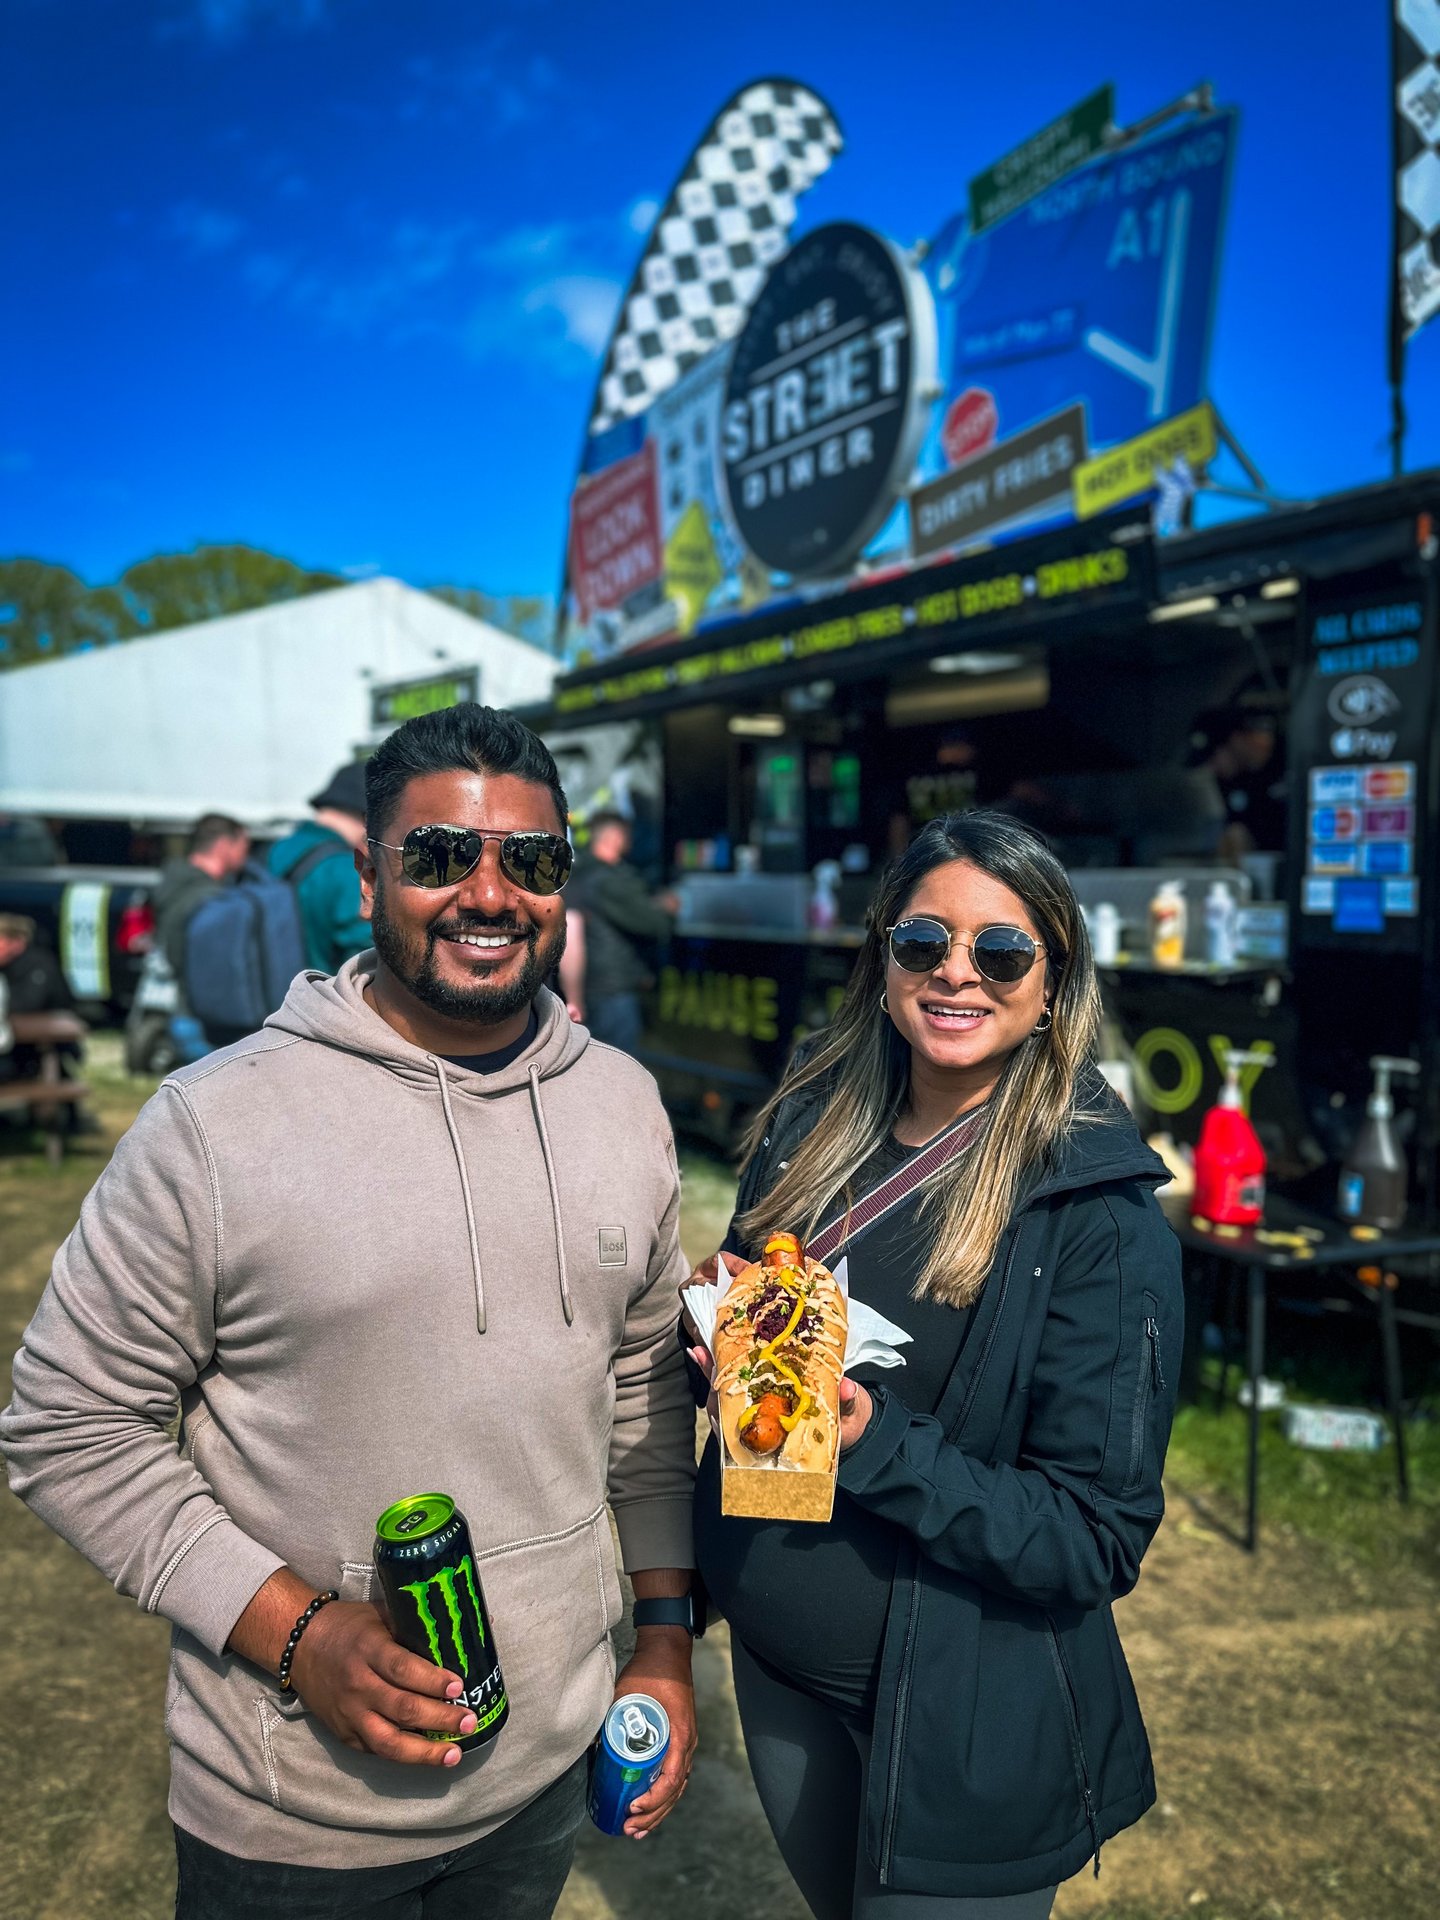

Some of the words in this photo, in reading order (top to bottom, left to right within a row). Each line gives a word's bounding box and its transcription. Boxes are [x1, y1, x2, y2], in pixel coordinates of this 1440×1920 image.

[1106, 197, 1166, 270] A1
[776, 297, 837, 352] THE
[722, 320, 907, 464] STREET
[743, 427, 874, 509] DINER
[918, 476, 989, 537] DIRTY
[993, 433, 1074, 498] FRIES
[856, 602, 905, 641] FRIES
[914, 588, 957, 628] HOT
[958, 572, 1022, 618] DOGS
[1035, 548, 1128, 599] DRINKS
[602, 1242, 625, 1252] BOSS
[1034, 1267, 1042, 1277] a
[399, 1544, 428, 1558] ZERO
[446, 1658, 502, 1708] NSTE
[477, 1697, 508, 1729] SUGA
